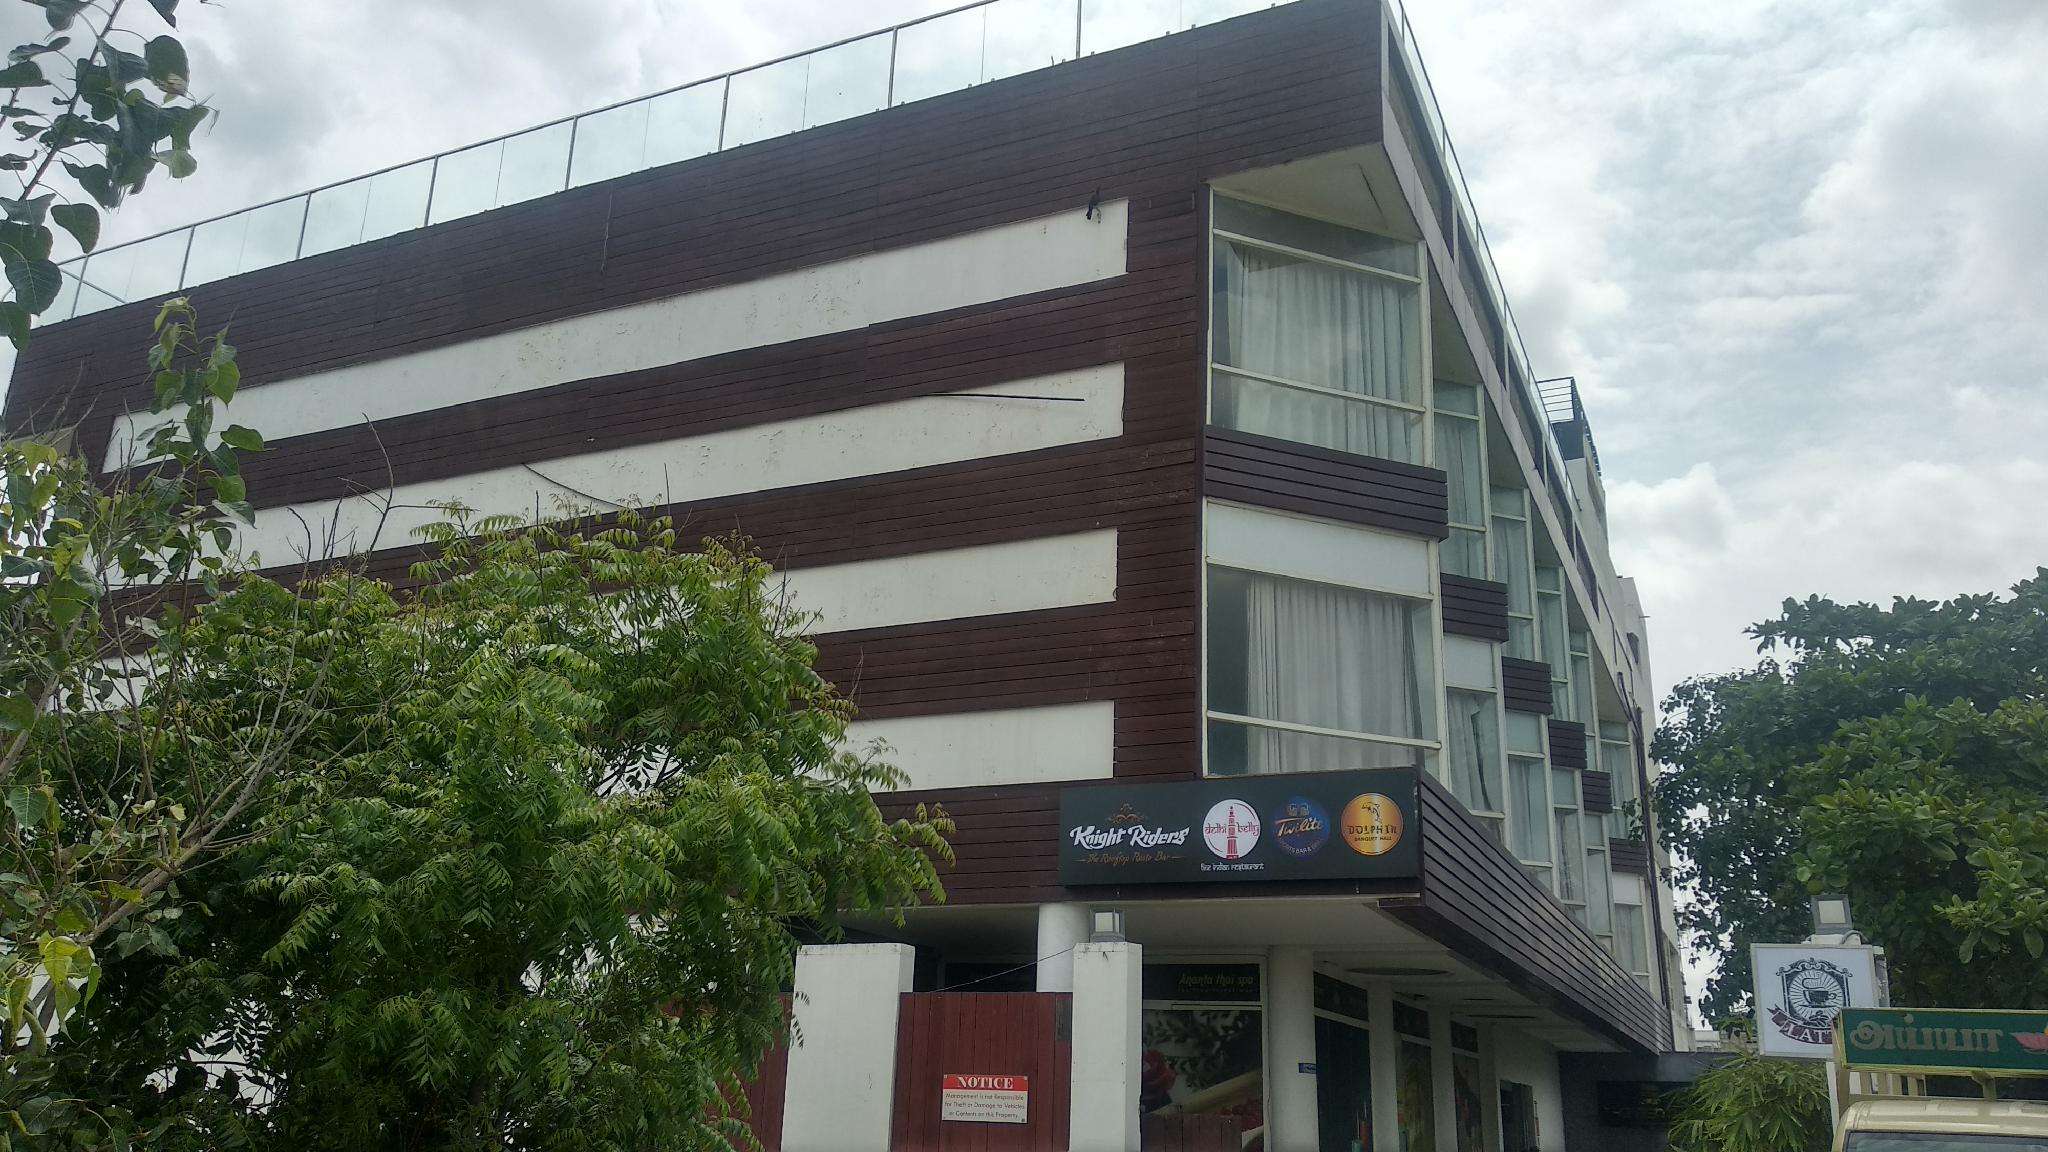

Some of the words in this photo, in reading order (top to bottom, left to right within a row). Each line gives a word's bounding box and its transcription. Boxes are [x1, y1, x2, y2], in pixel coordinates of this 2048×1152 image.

[1205, 823, 1227, 834] delhi
[1236, 821, 1260, 836] belly
[1274, 817, 1323, 837] Twilite
[1346, 825, 1398, 834] DOLPHIN
[1070, 825, 1127, 850] Knight
[1127, 824, 1191, 848] Riders
[957, 1077, 1014, 1089] NOTICE
